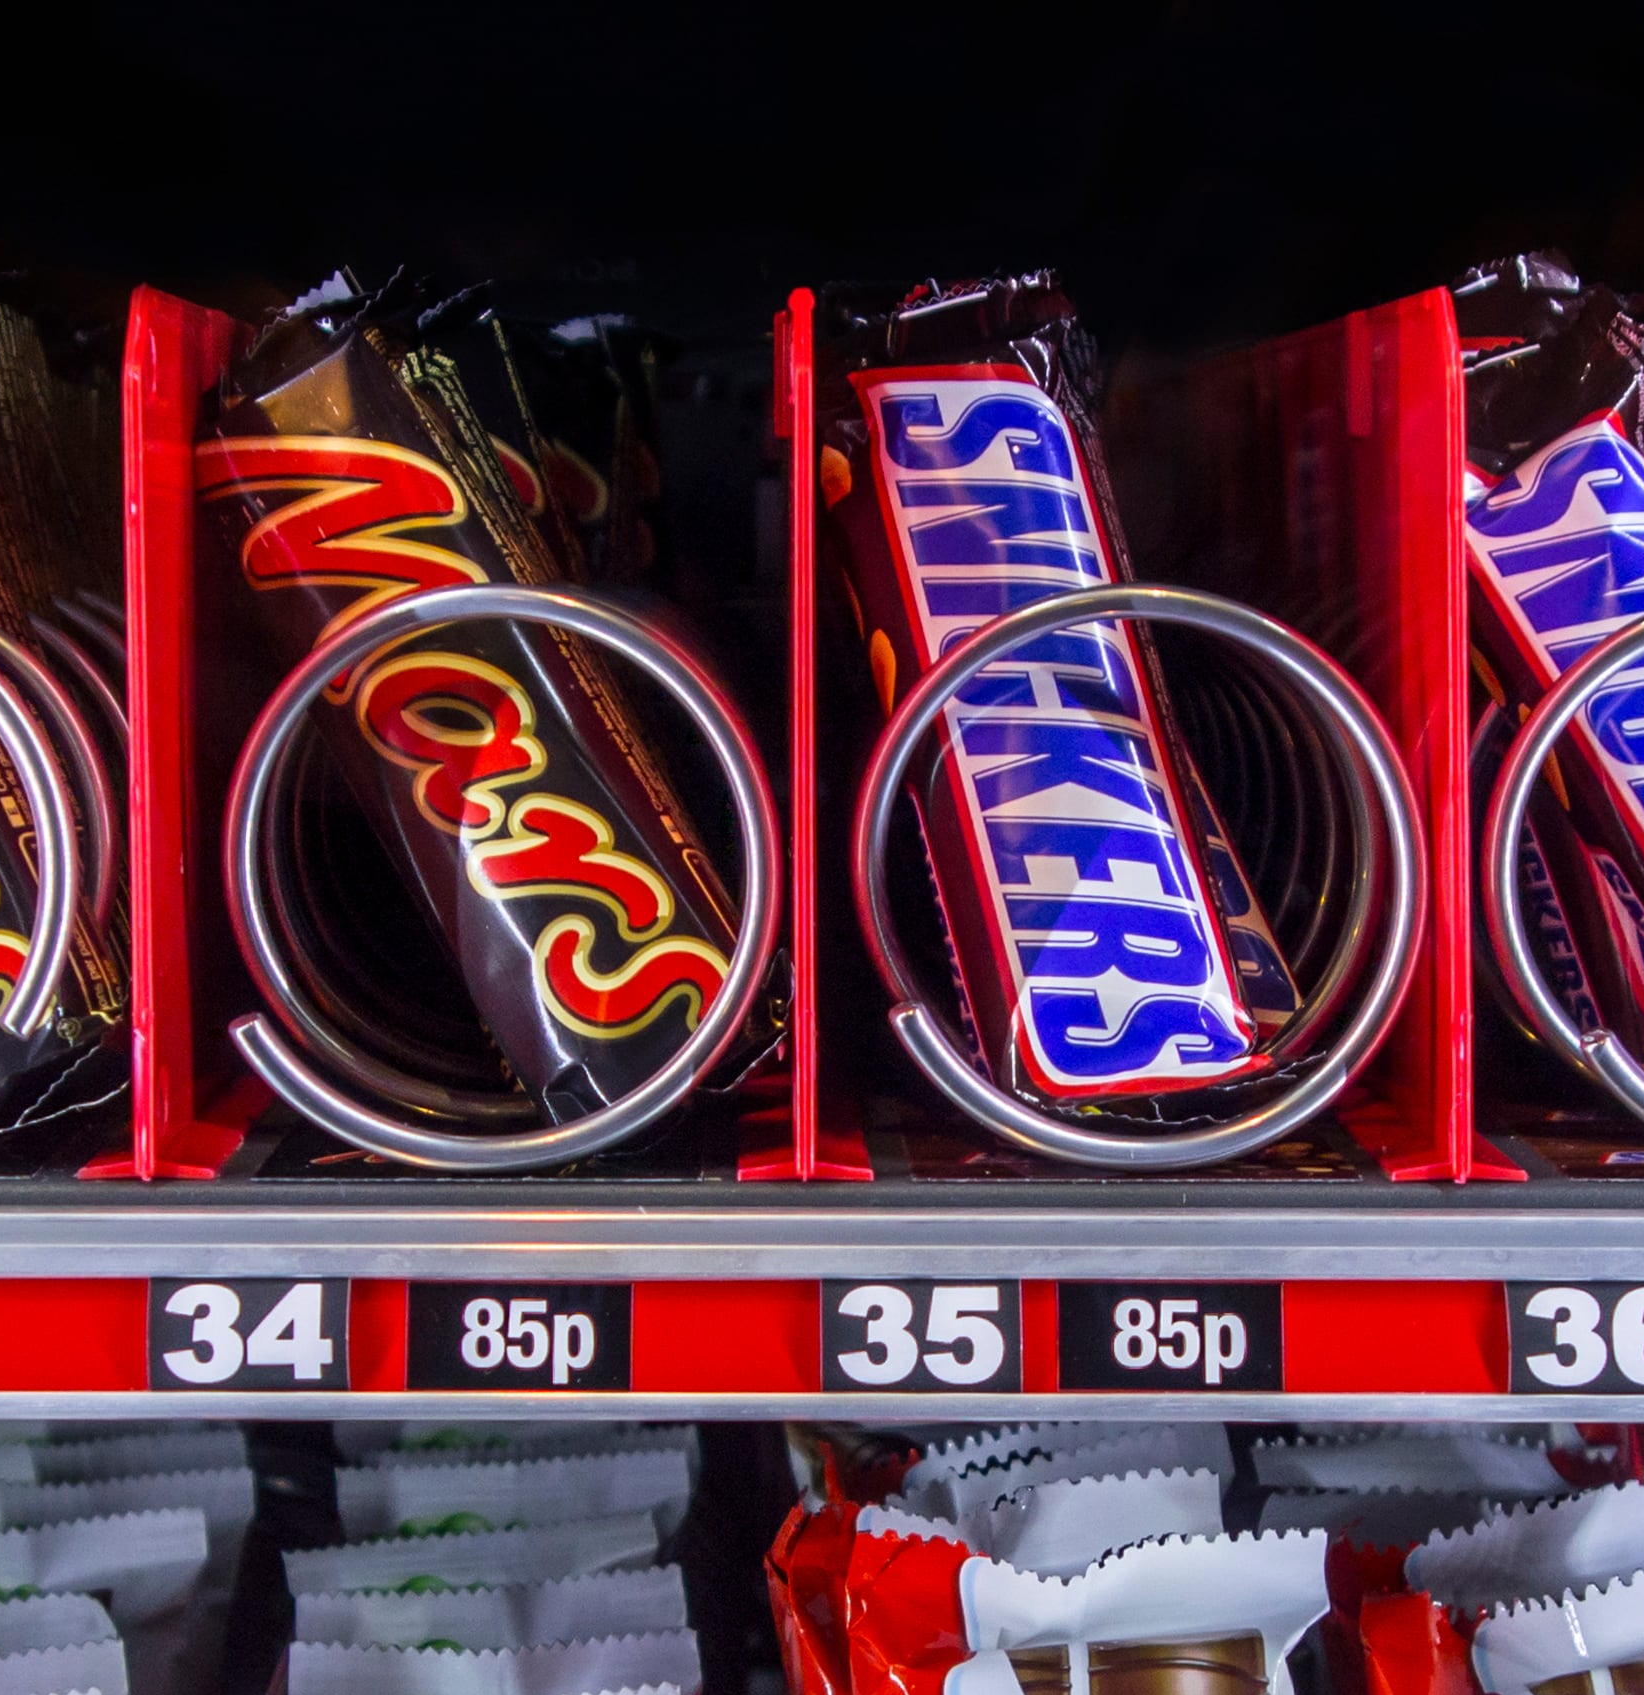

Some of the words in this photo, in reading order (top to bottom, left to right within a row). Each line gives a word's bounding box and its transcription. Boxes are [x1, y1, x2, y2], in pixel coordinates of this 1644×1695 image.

[194, 433, 736, 1039] Mars
[878, 392, 1253, 1080] SNICKERS
[164, 1284, 332, 1383] 34
[462, 1299, 594, 1384] 85p
[838, 1286, 1004, 1384] 35
[1114, 1299, 1246, 1383] 85p
